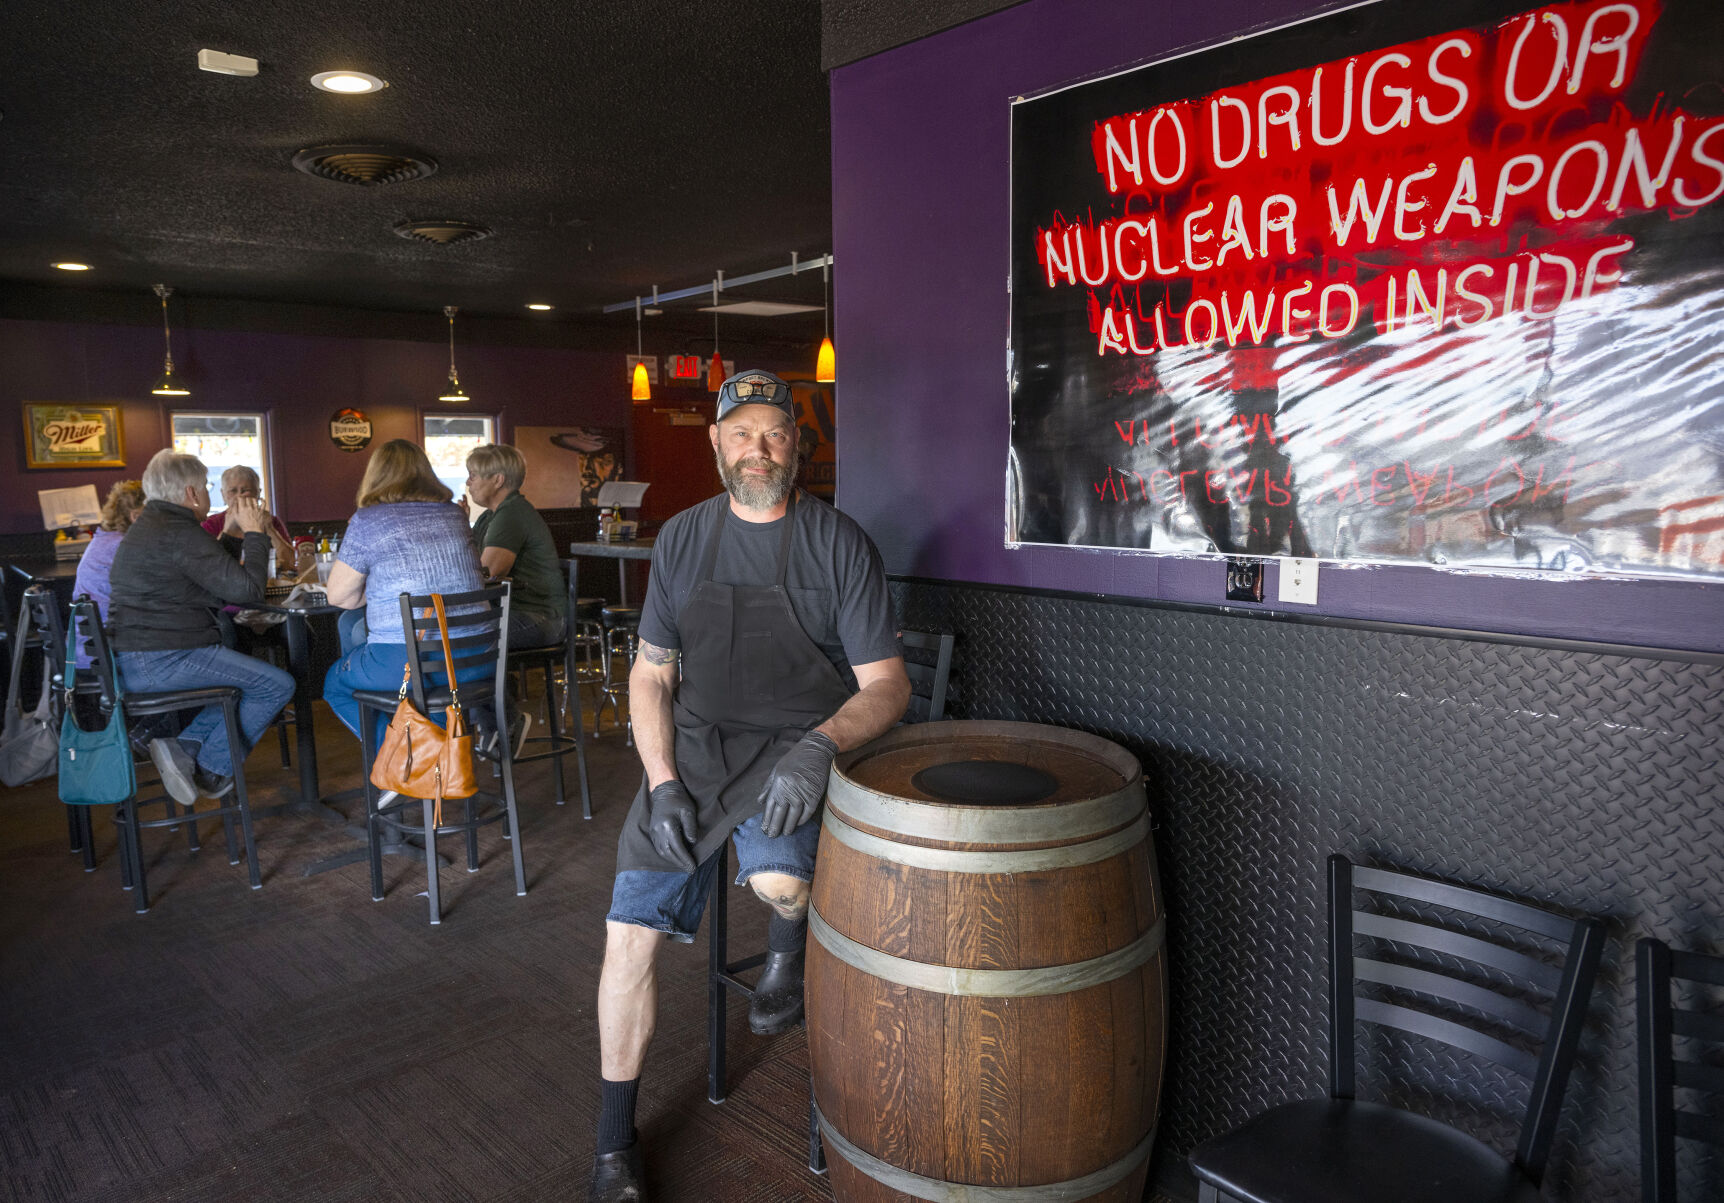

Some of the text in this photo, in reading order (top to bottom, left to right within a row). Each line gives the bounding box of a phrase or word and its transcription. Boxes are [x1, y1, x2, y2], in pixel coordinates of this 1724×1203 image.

[1104, 4, 1640, 193] NO DRUGS OR
[1043, 116, 1724, 288] NUCLEAR WEAPONS
[1098, 280, 1360, 358] ALLOWED
[676, 355, 699, 378] EXIT
[45, 424, 103, 446] Miller
